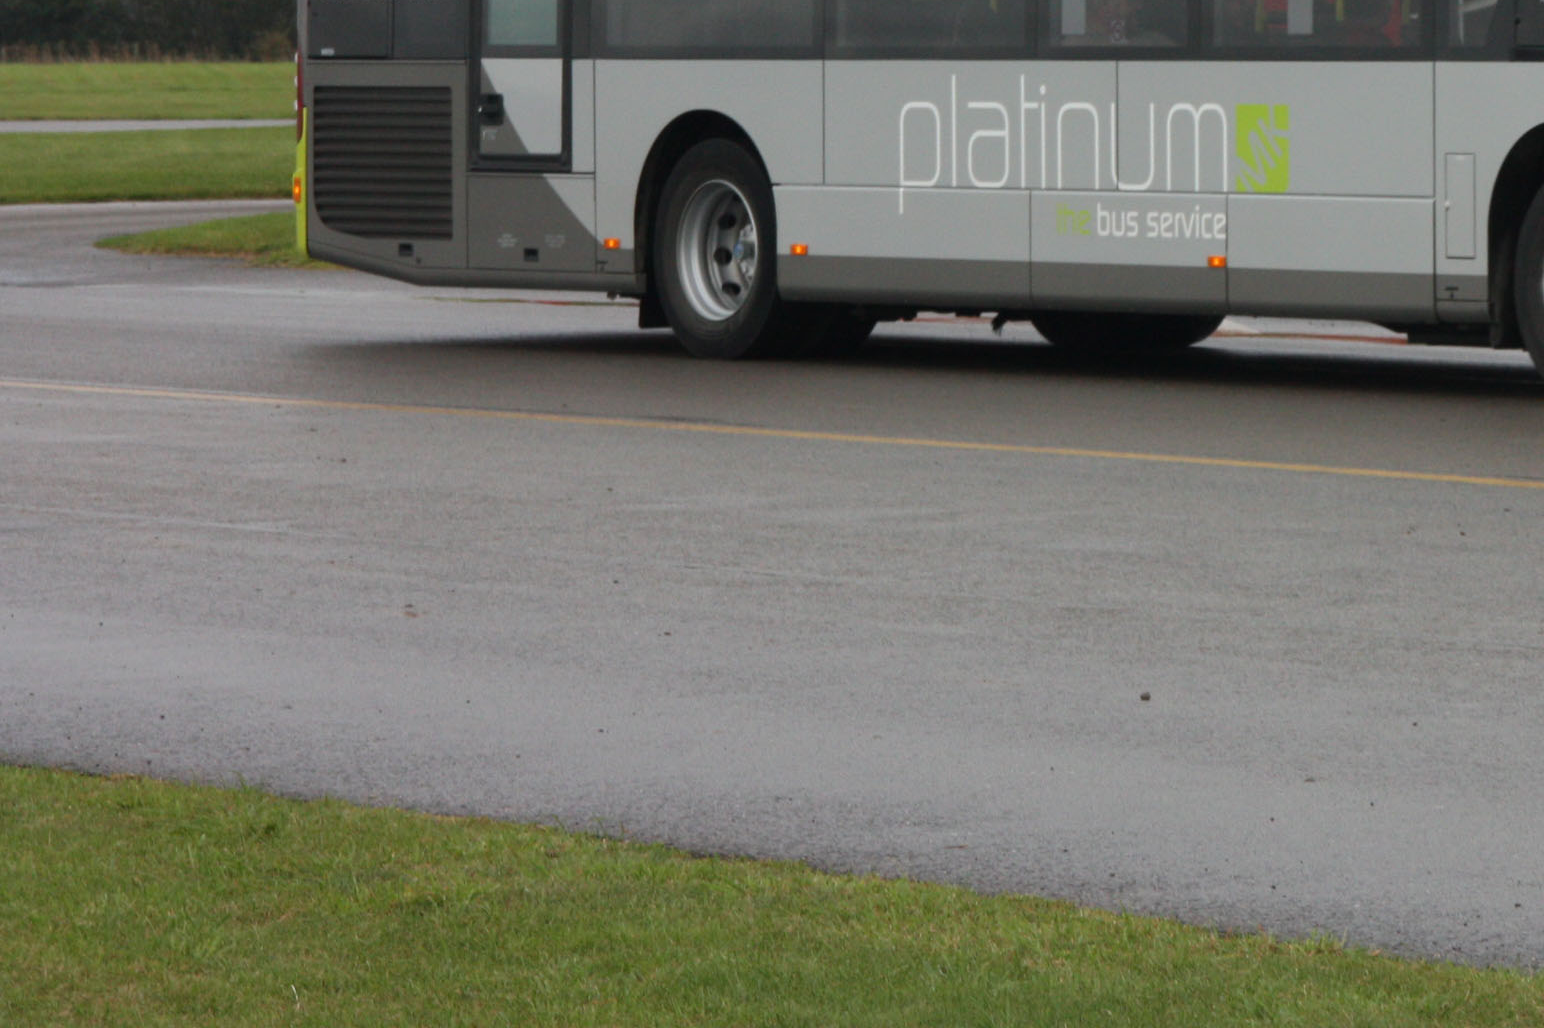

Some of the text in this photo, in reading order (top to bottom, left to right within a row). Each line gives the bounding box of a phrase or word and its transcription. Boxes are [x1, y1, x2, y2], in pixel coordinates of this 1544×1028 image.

[899, 74, 1228, 215] platinum
[1056, 201, 1227, 239] the bus service
